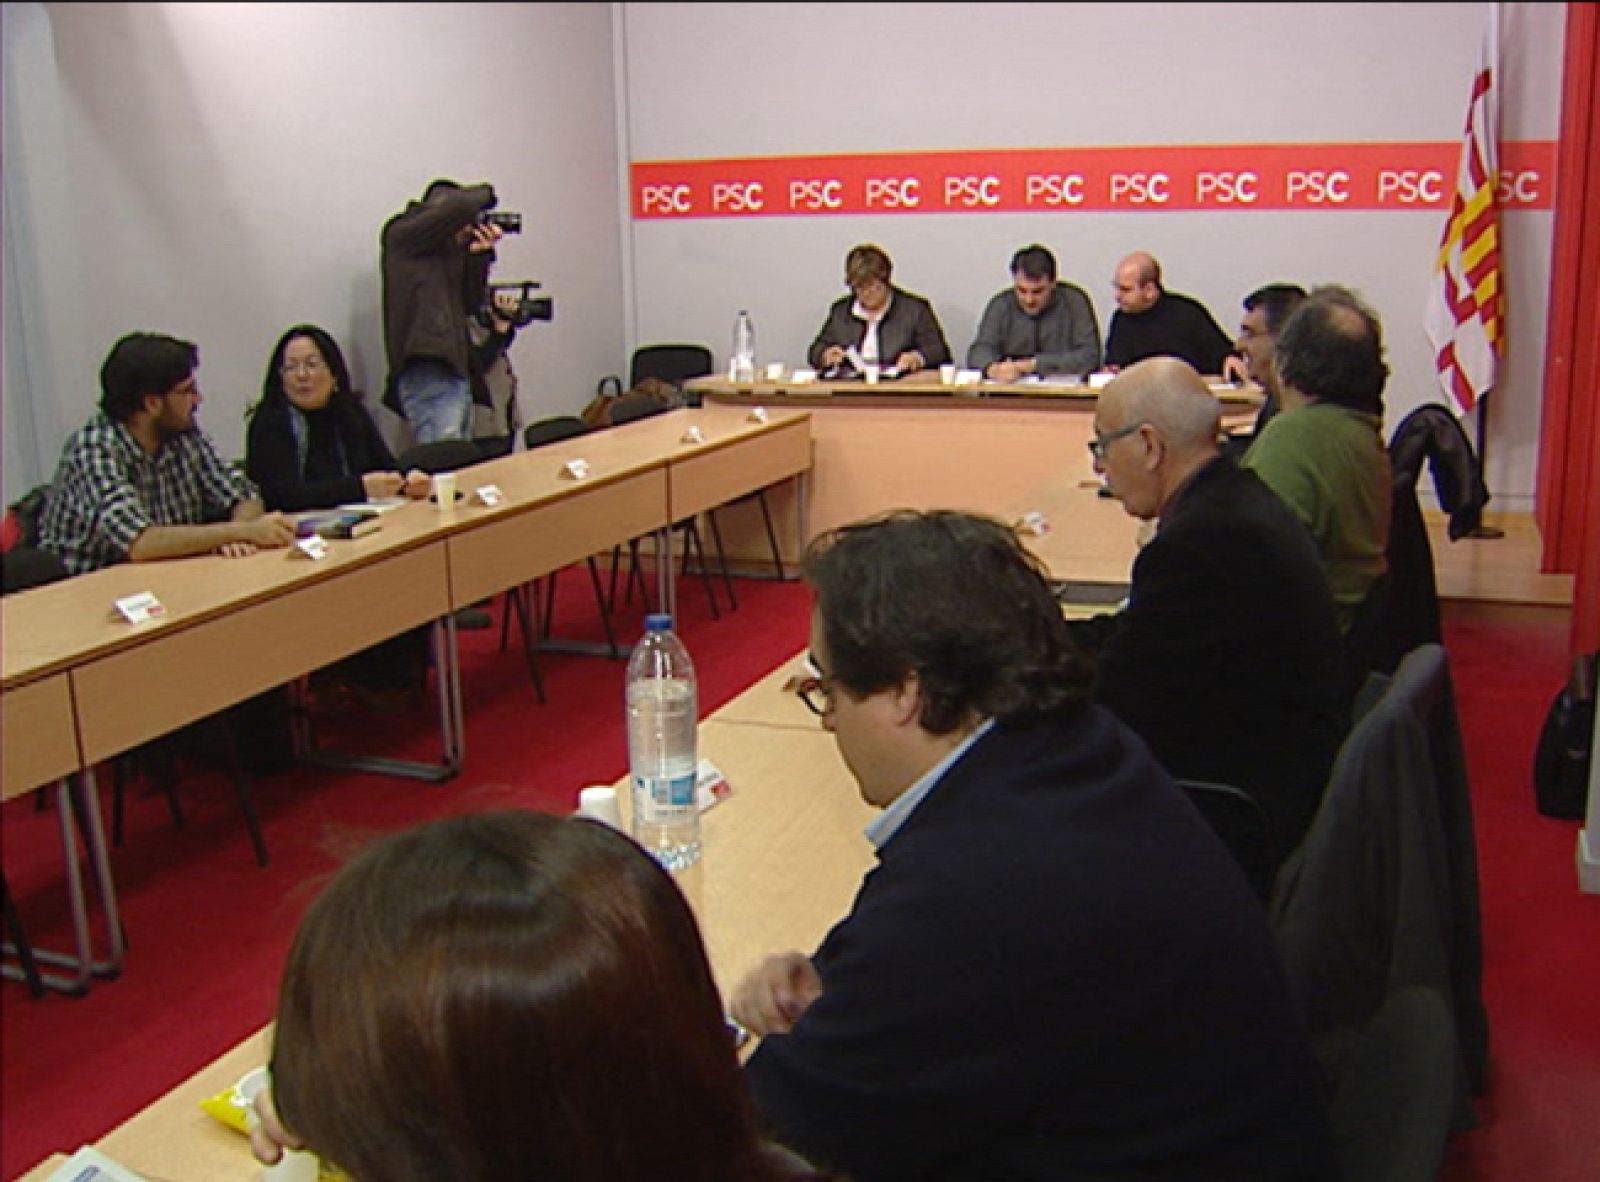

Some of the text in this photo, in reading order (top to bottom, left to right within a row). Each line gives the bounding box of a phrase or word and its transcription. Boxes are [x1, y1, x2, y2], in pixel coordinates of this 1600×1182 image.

[642, 171, 1539, 212] PSC PSC PSC PSC PSC PSC PSC PSC PSC PSC SC
